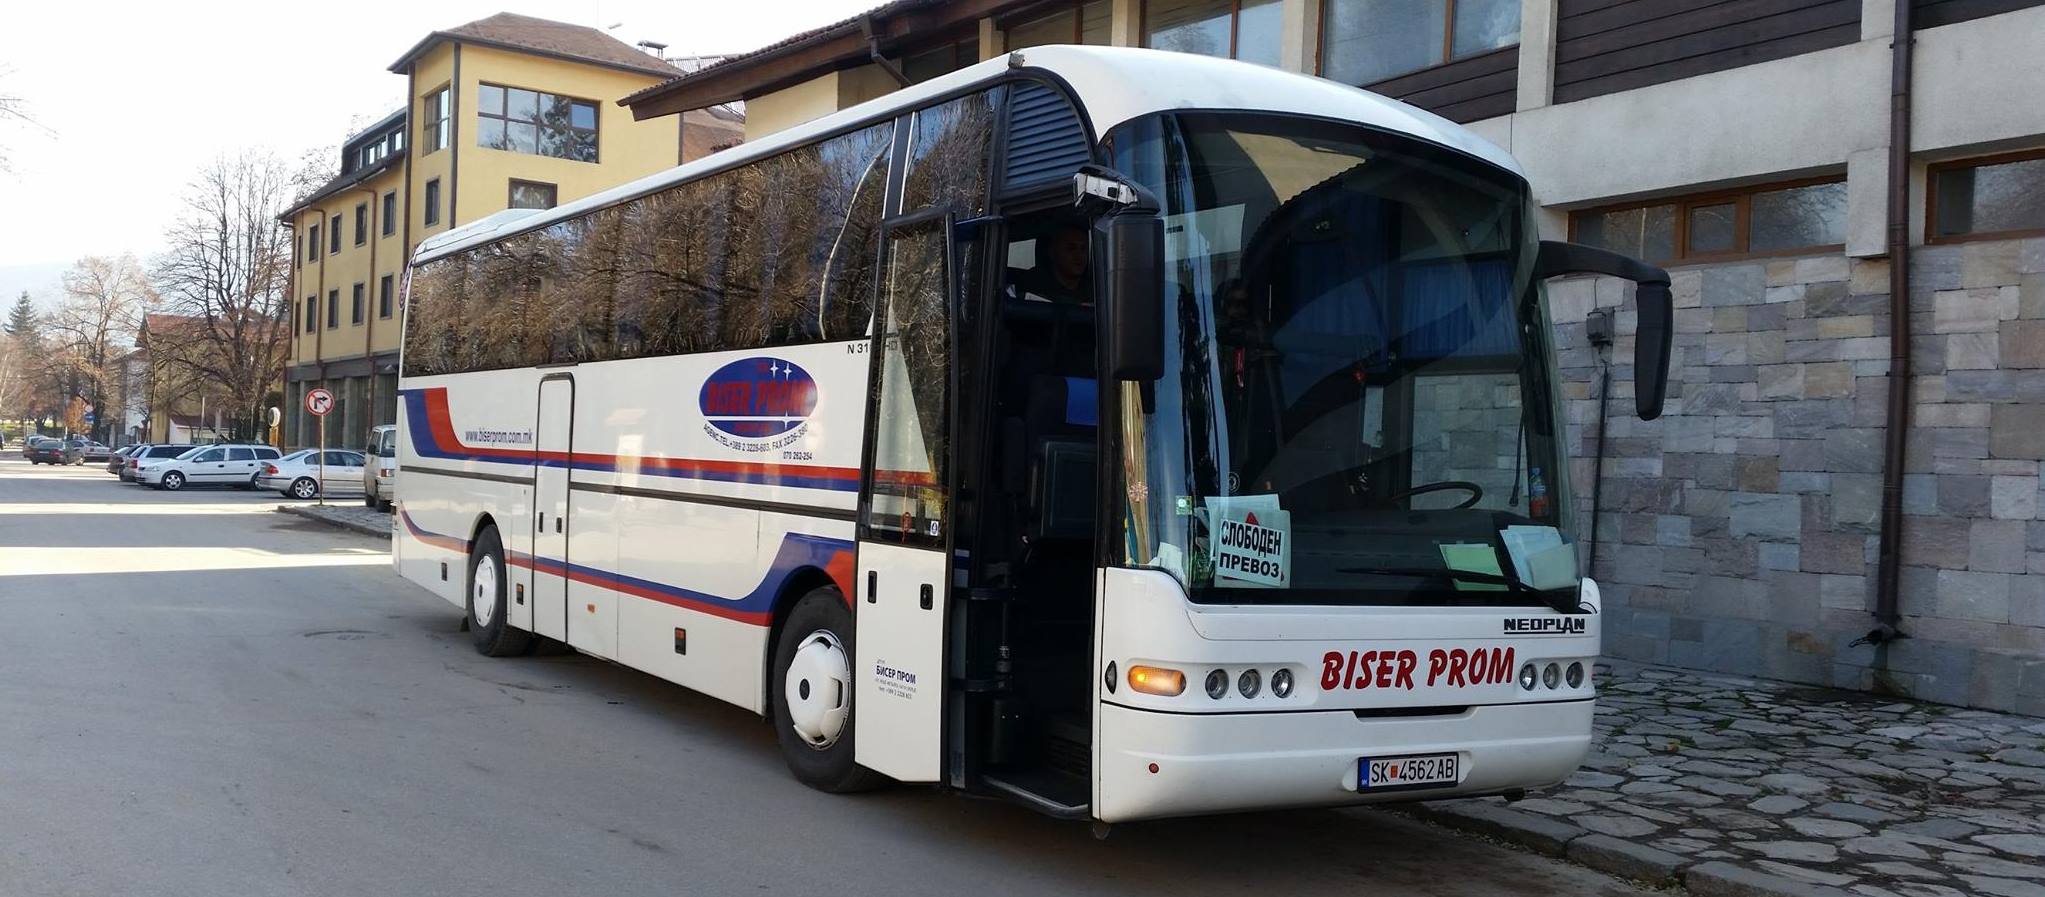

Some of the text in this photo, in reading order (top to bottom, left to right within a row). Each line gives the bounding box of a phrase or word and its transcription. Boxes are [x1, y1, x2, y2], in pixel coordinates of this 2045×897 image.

[847, 344, 855, 354] N
[857, 343, 869, 353] 31
[465, 427, 532, 446] www.biserprom.com.mk
[1221, 520, 1282, 558] СЛОБОДЕН
[1219, 552, 1280, 578] ПРЕВОЗ
[1503, 617, 1585, 634] NEOPLAN
[876, 665, 916, 684] БИСЕР ПРОМ
[1320, 646, 1515, 691] BISER PROM
[1371, 762, 1390, 783] SK
